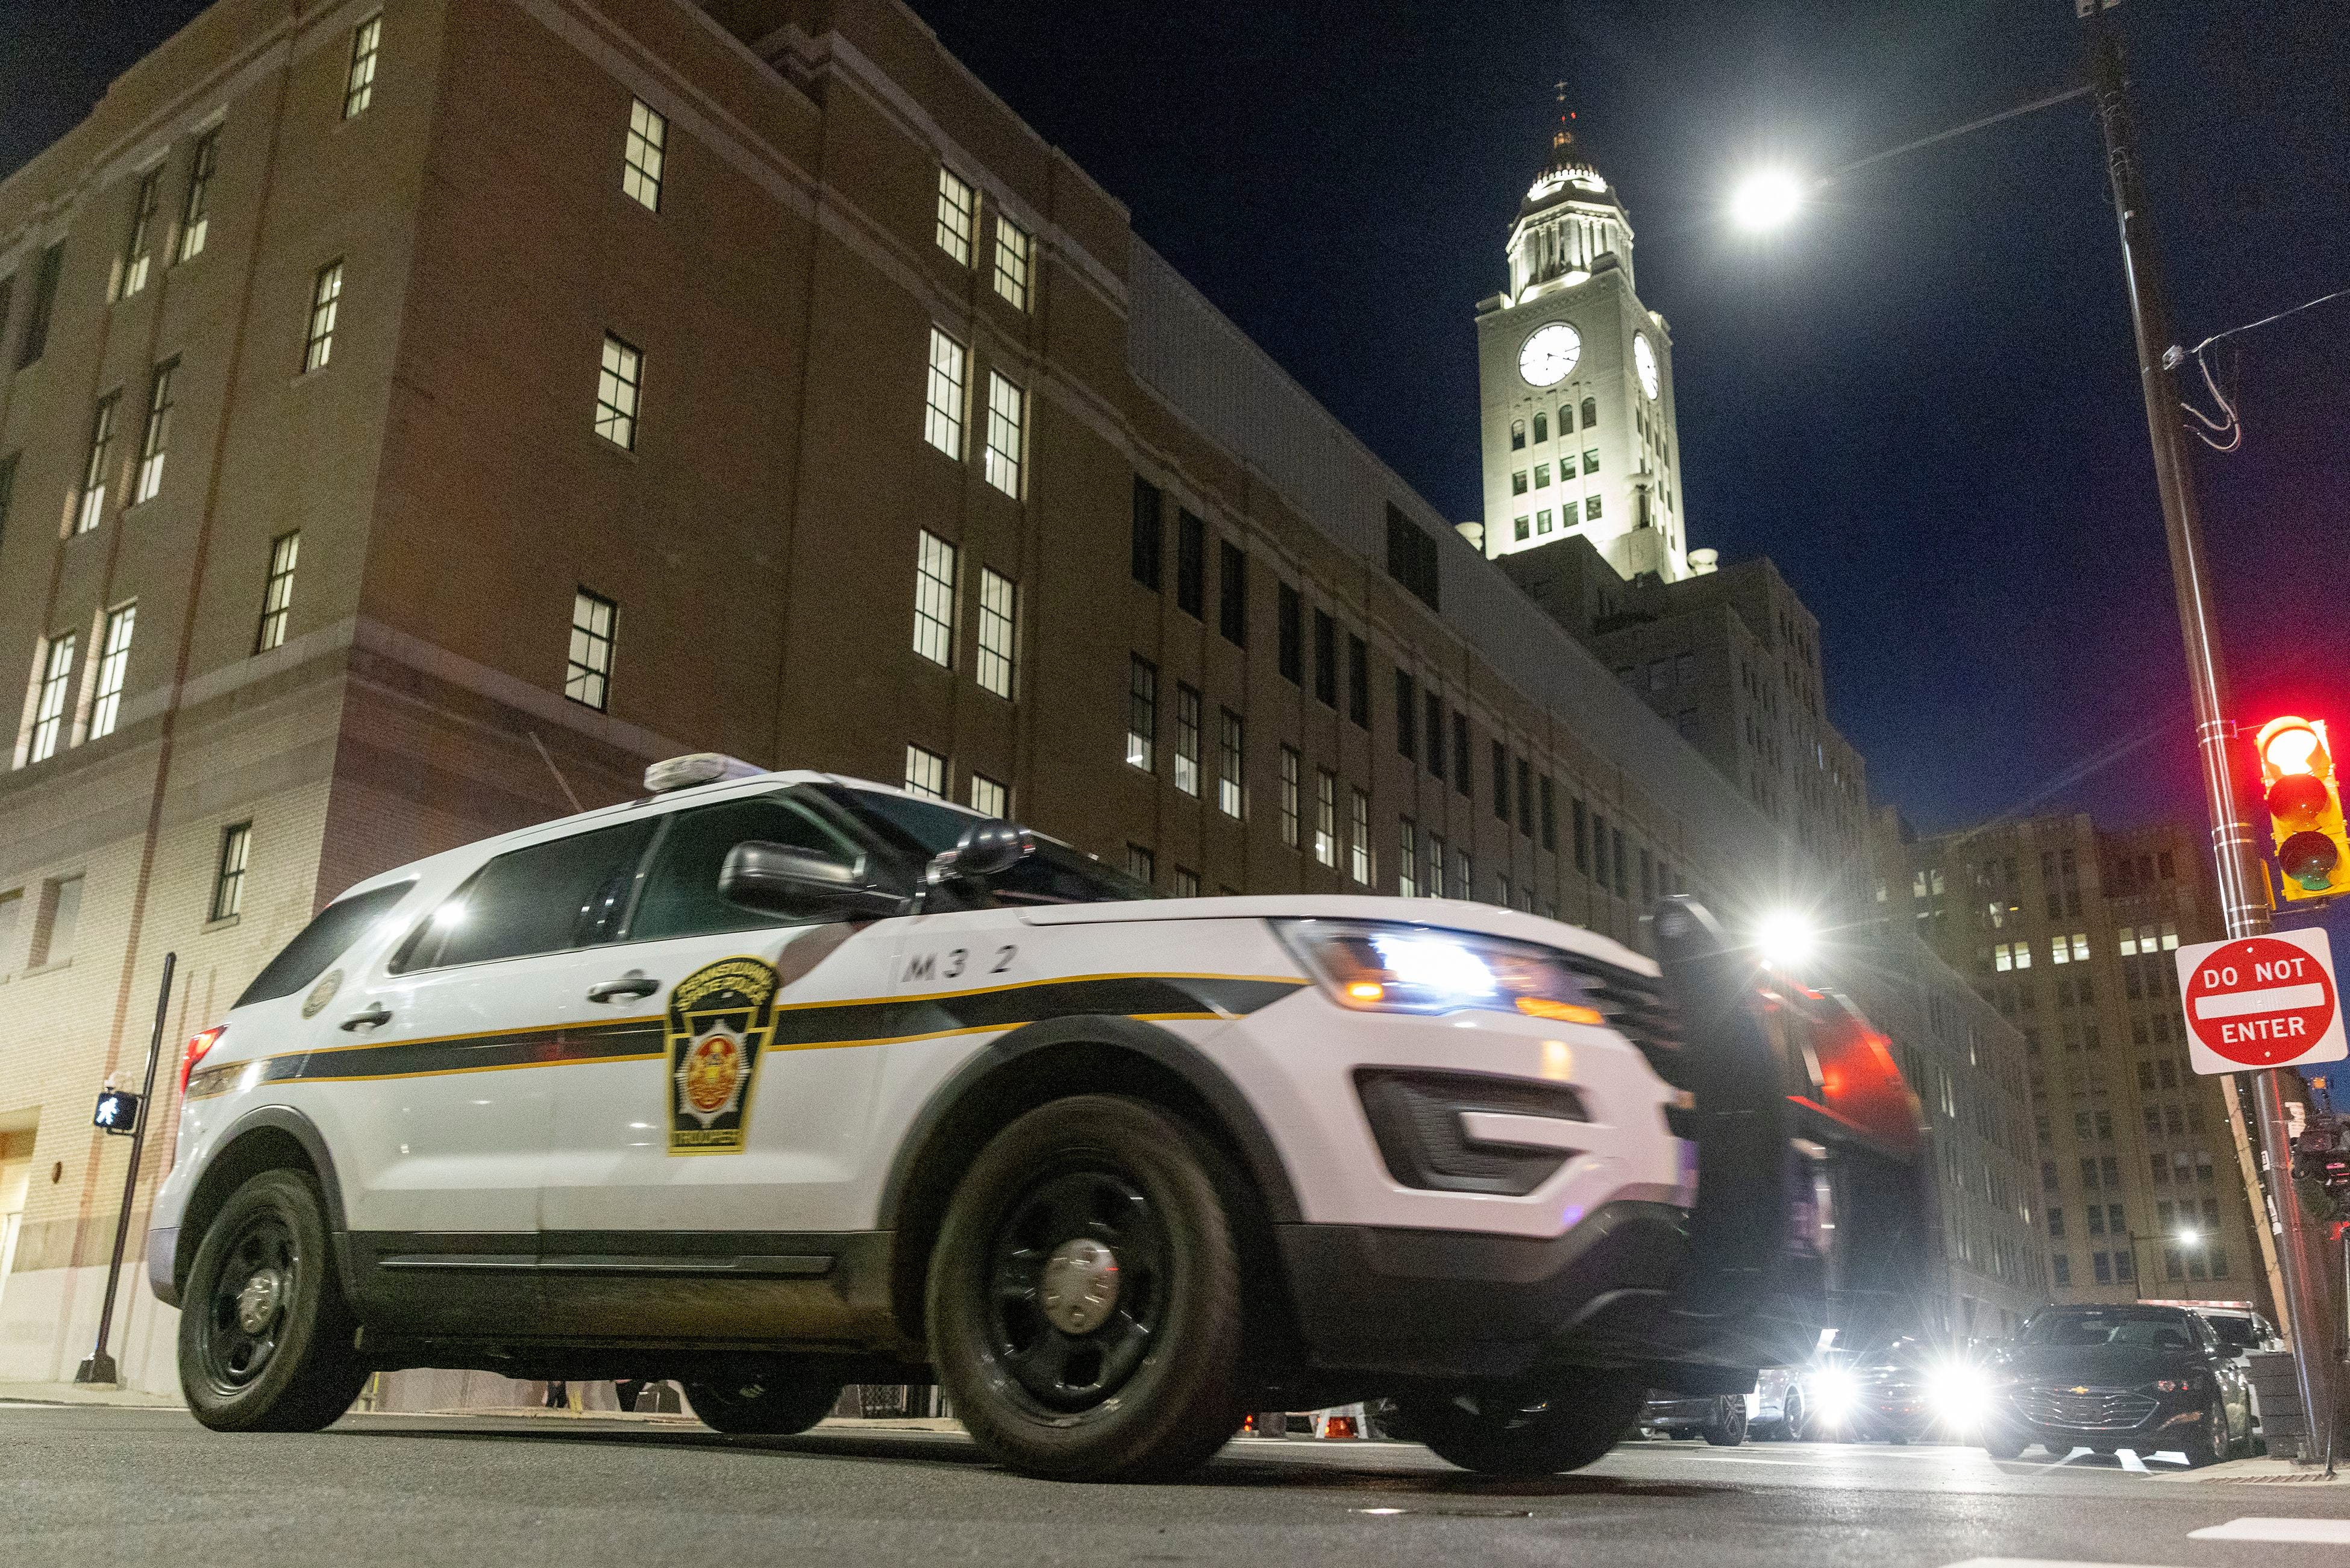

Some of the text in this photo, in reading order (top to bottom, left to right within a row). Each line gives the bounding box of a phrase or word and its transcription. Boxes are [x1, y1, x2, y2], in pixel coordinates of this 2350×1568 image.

[2203, 958, 2305, 989] DO NOT
[2222, 1016, 2306, 1044] ENTER
